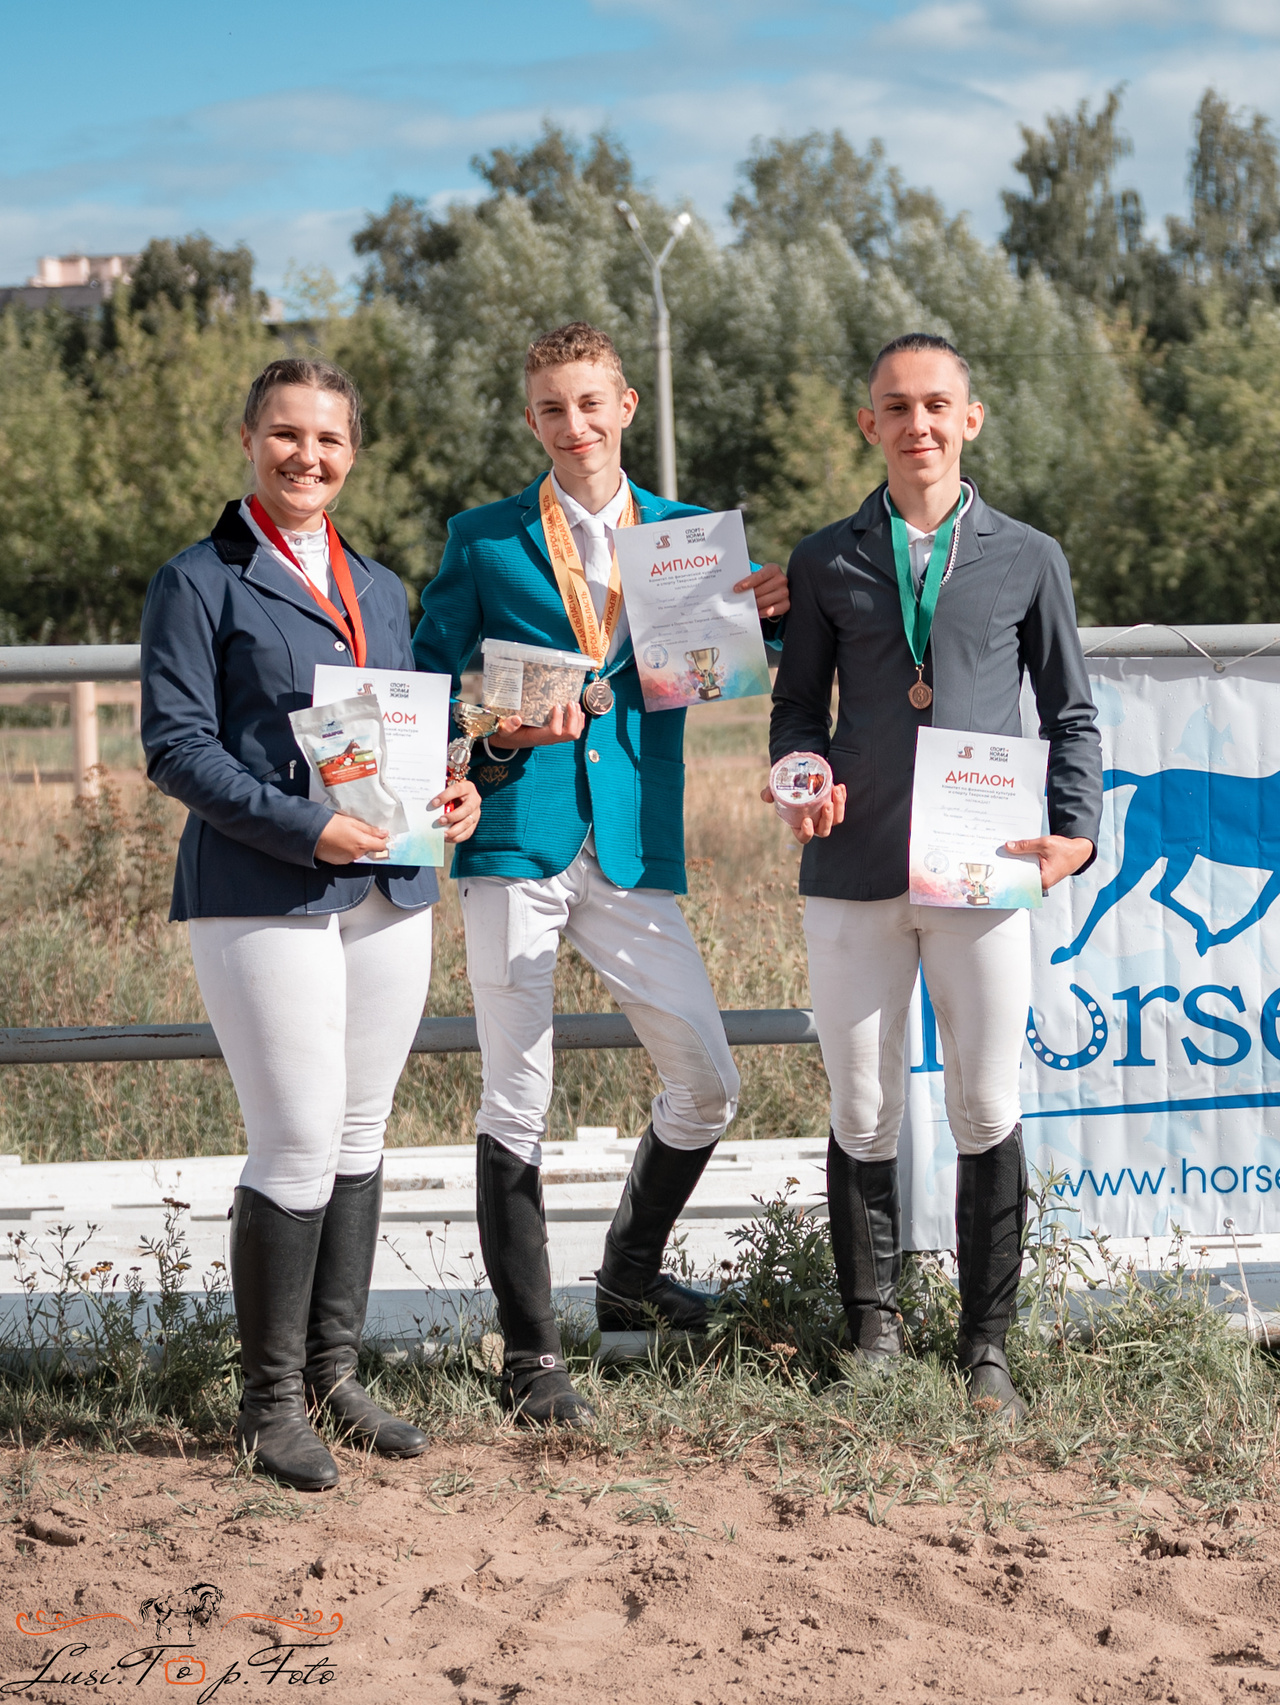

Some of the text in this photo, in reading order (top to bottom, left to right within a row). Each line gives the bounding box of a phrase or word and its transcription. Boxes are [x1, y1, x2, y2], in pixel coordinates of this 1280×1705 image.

[650, 554, 718, 577] ДИПЛОМ
[382, 711, 416, 725] ЛОМ
[945, 770, 1015, 788] ДИПЛОМ
